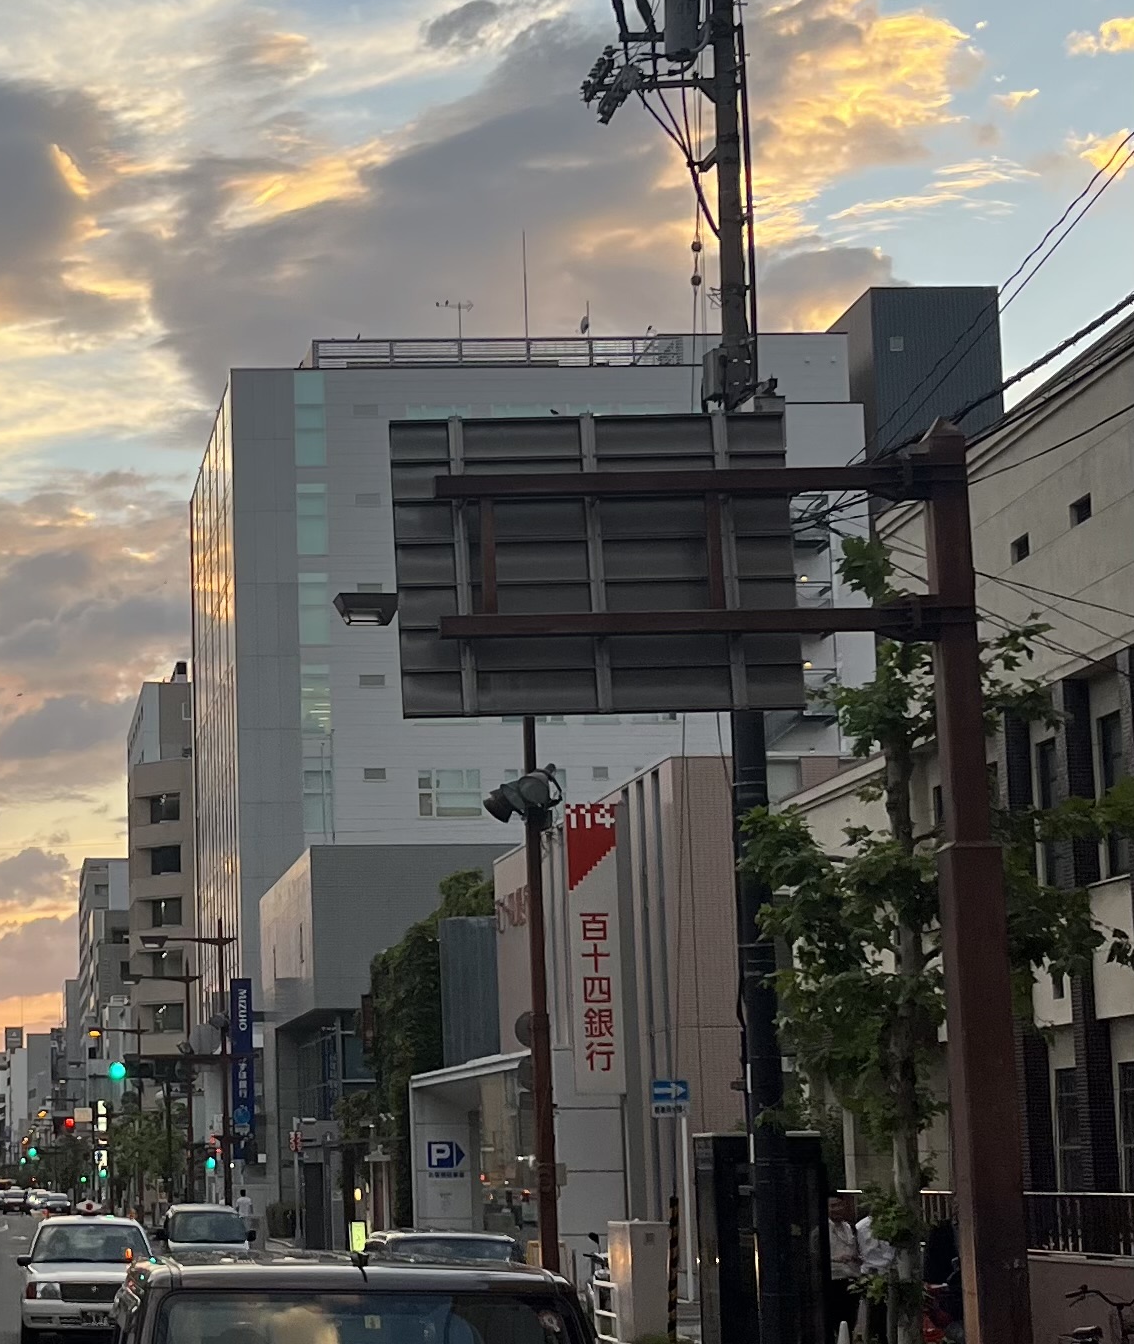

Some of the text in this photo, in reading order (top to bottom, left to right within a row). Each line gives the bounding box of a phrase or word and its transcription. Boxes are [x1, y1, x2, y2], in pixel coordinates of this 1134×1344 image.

[566, 804, 616, 829] 114
[579, 912, 615, 1072] 百十四銀行
[238, 988, 248, 1031] MIZUHO
[431, 1144, 451, 1166] P
